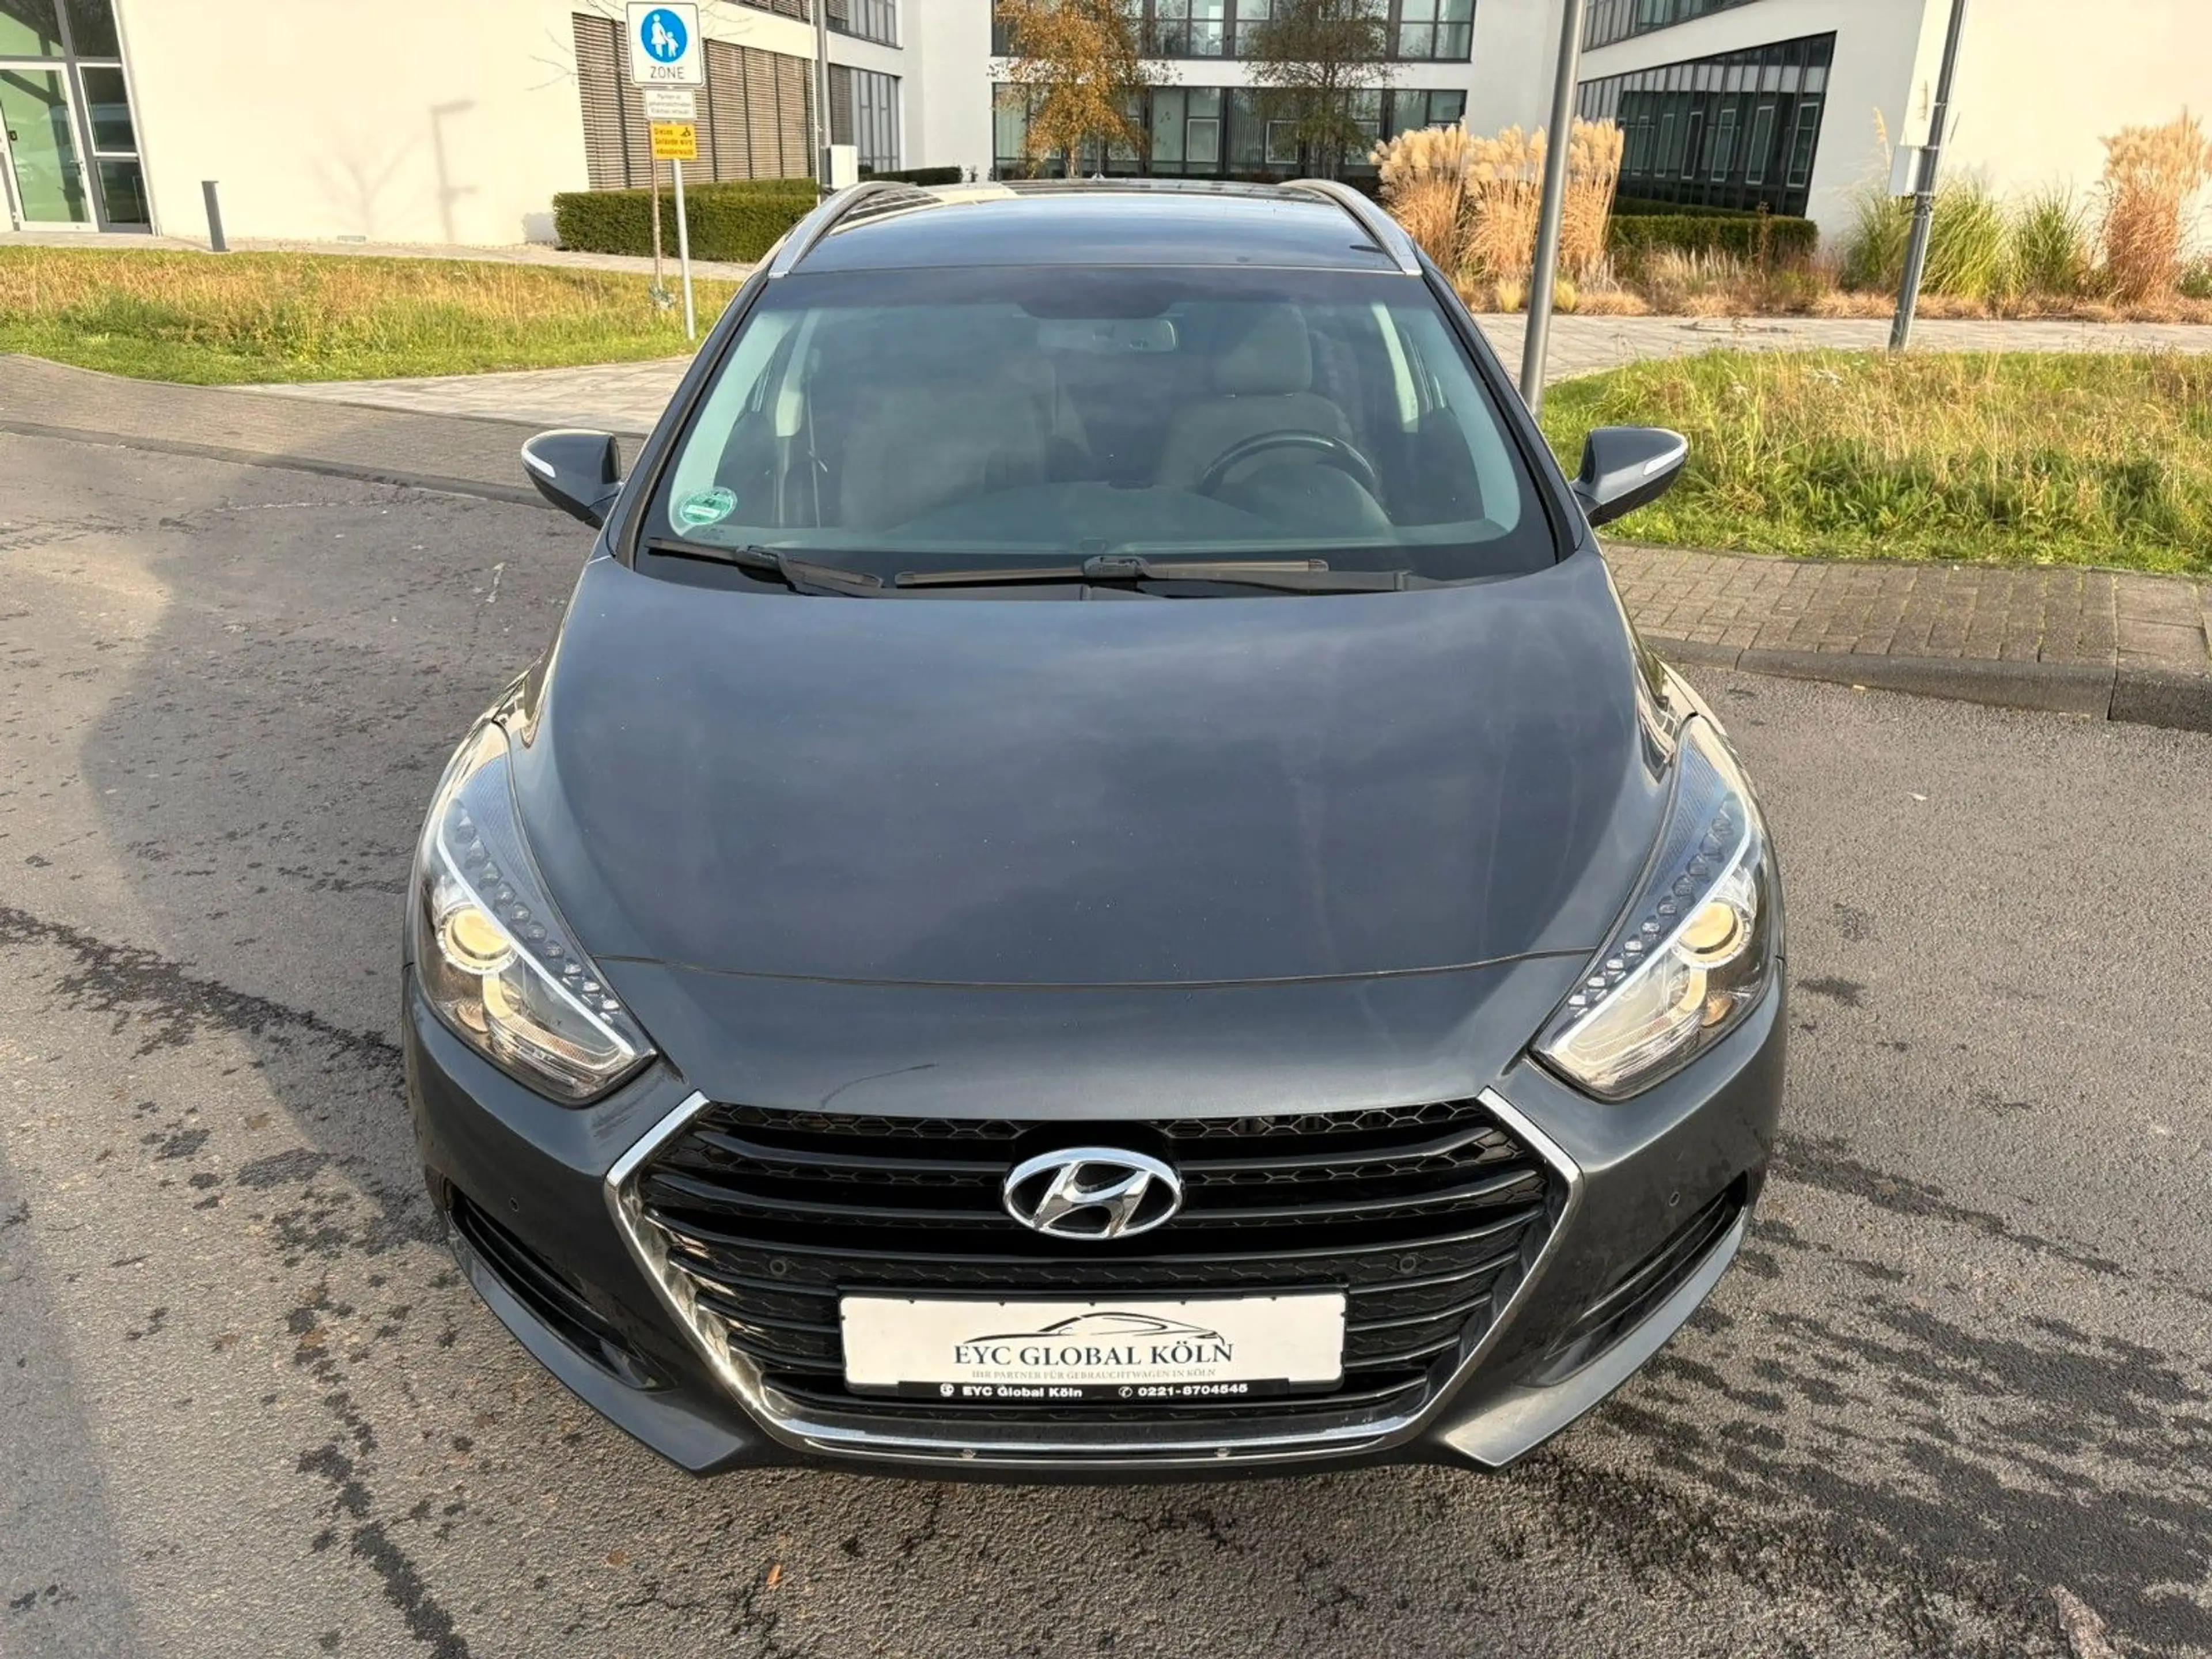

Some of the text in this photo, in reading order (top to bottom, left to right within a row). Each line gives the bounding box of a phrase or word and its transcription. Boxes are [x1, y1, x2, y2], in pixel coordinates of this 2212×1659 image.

[650, 66, 684, 79] ZONE
[954, 1340, 1234, 1366] EYC GLOBAL KÖLN
[972, 1369, 1217, 1380] IHR PARTNER FÜR GEBRAUCHTWAGEN IN KÖLN
[962, 1384, 1248, 1397] EYC Global Köln 0221-8704545
